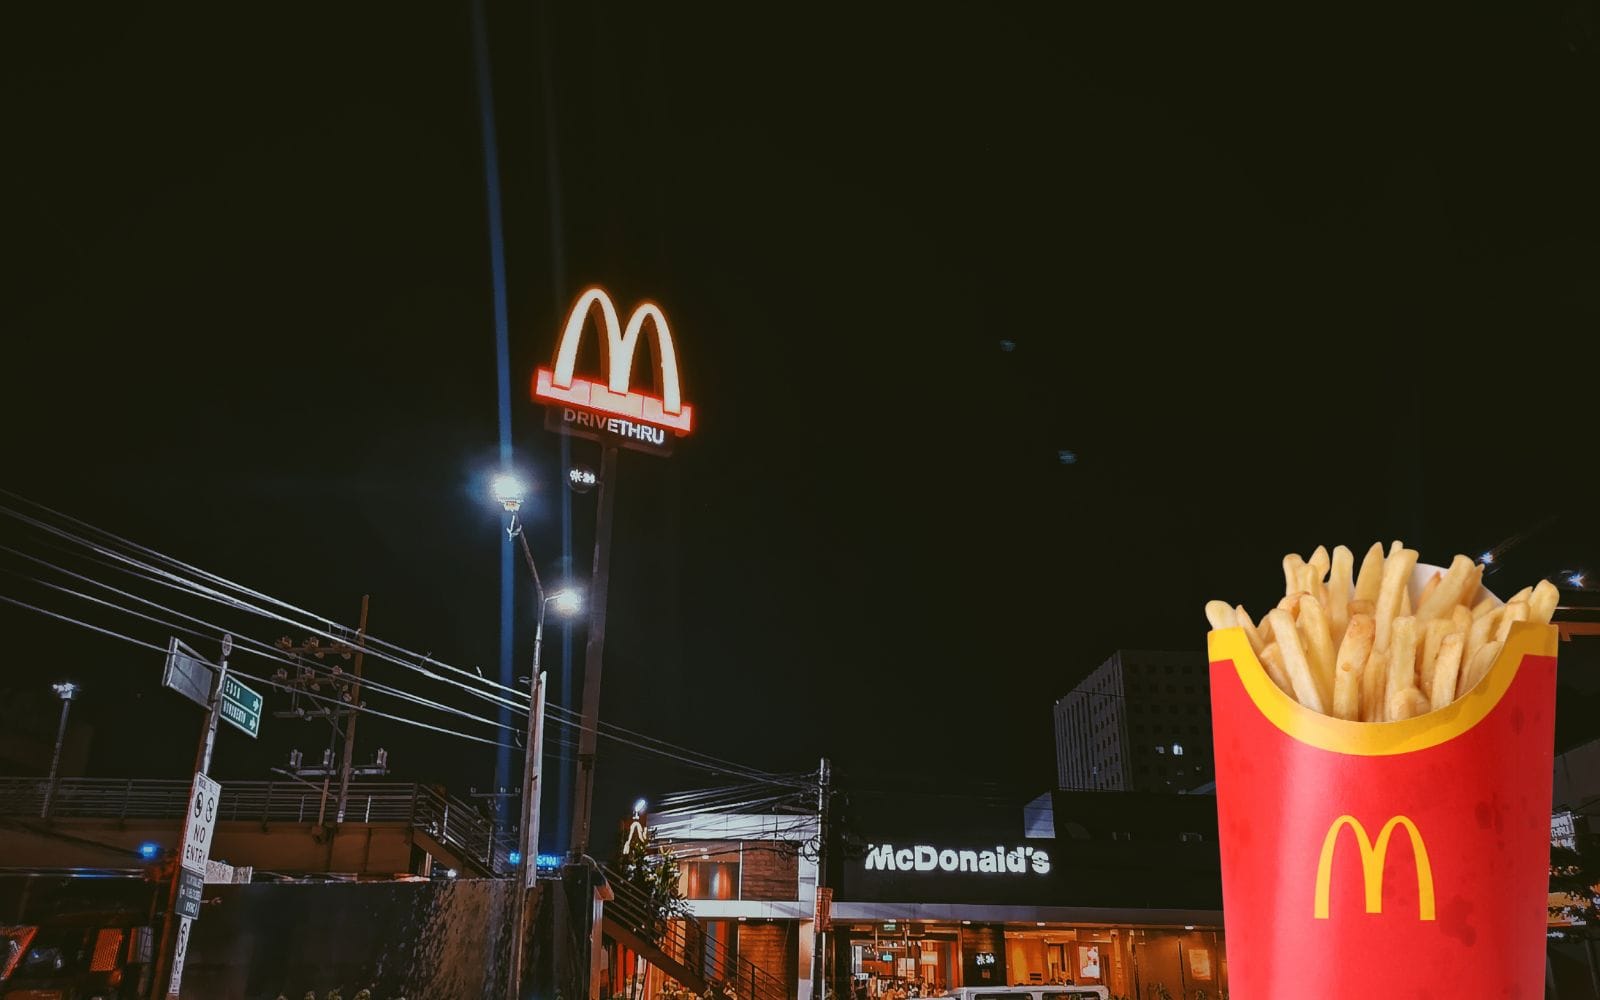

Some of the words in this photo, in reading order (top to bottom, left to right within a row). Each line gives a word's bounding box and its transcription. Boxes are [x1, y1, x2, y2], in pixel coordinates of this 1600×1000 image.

[193, 824, 206, 844] NO
[186, 844, 206, 867] ENTRY
[864, 844, 1050, 874] McDonald's
